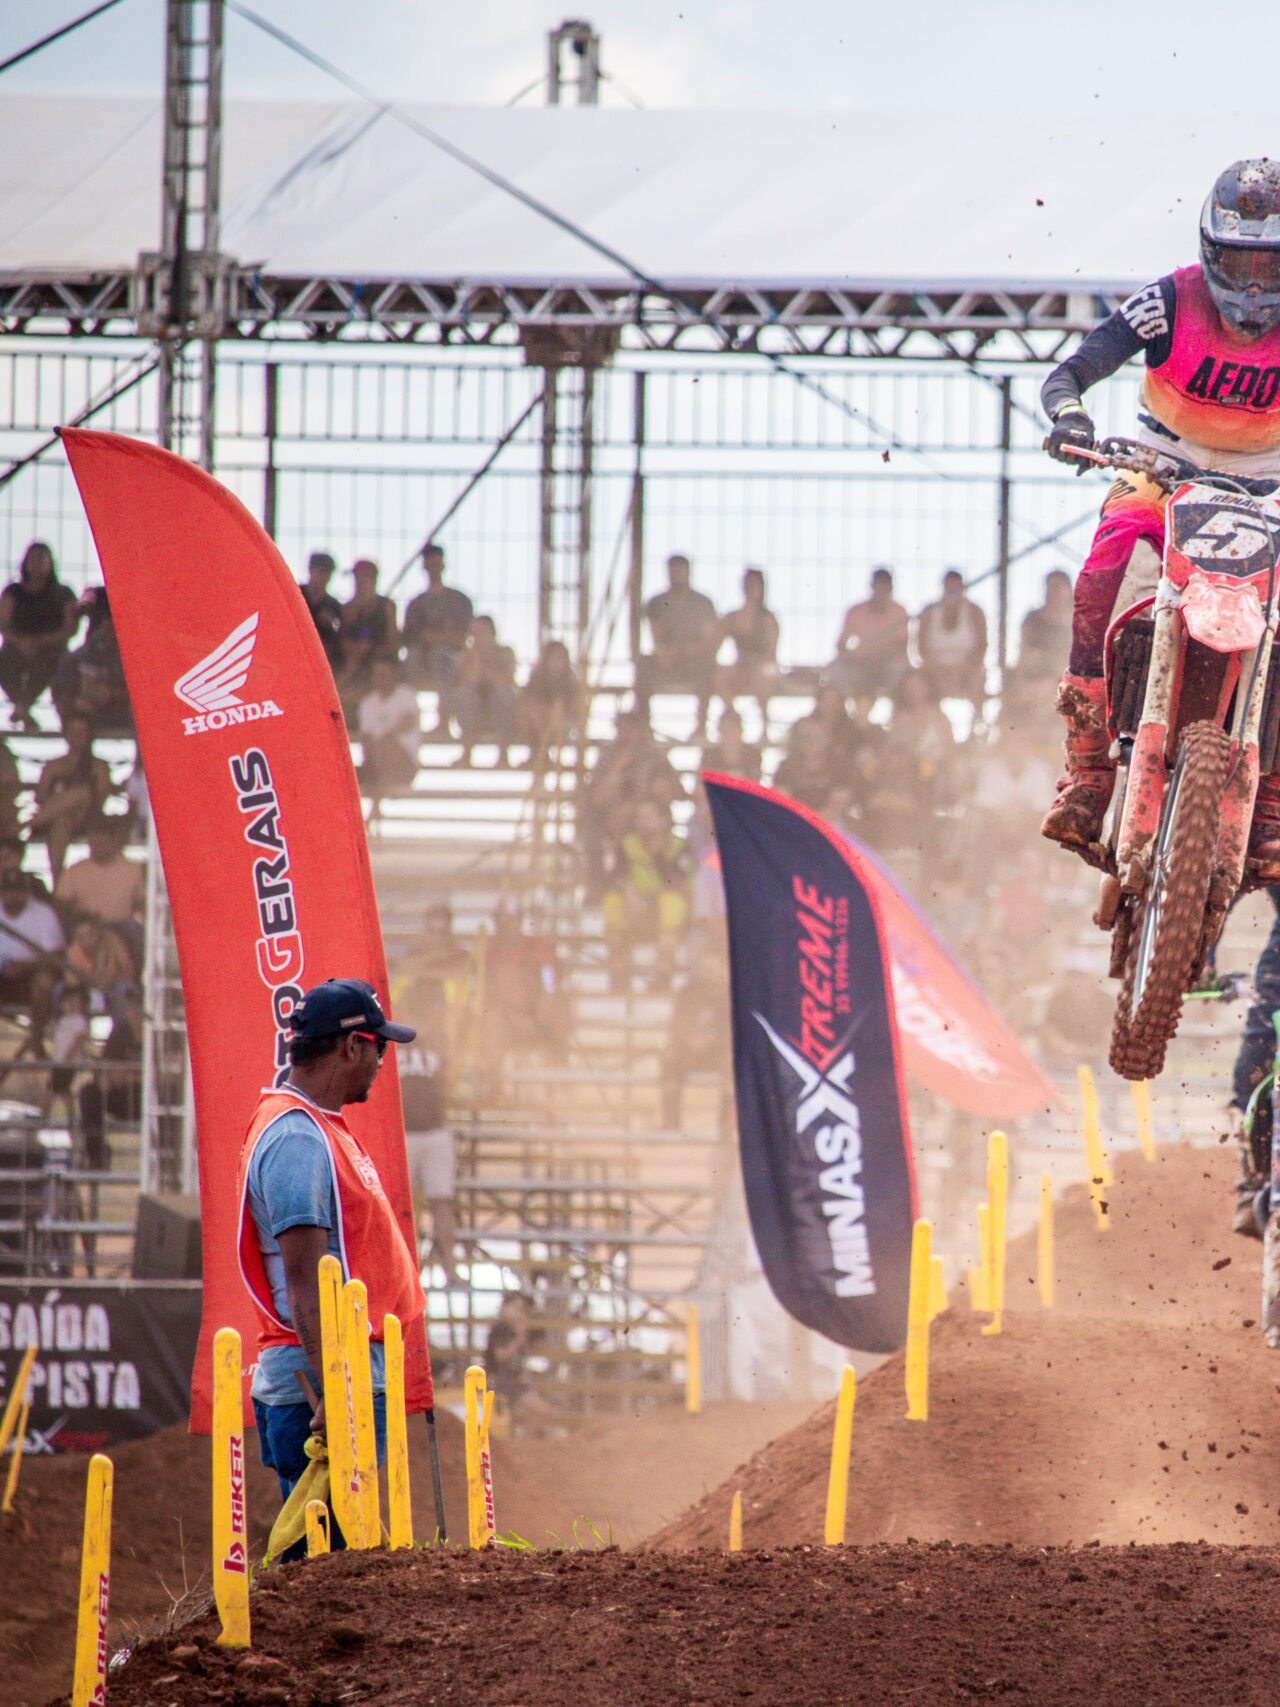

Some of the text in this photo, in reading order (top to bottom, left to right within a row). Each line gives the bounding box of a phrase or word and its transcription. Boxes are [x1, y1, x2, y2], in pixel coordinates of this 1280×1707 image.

[1119, 278, 1169, 340] ERO
[182, 700, 284, 735] HONDA
[22, 1361, 141, 1410] PISTA
